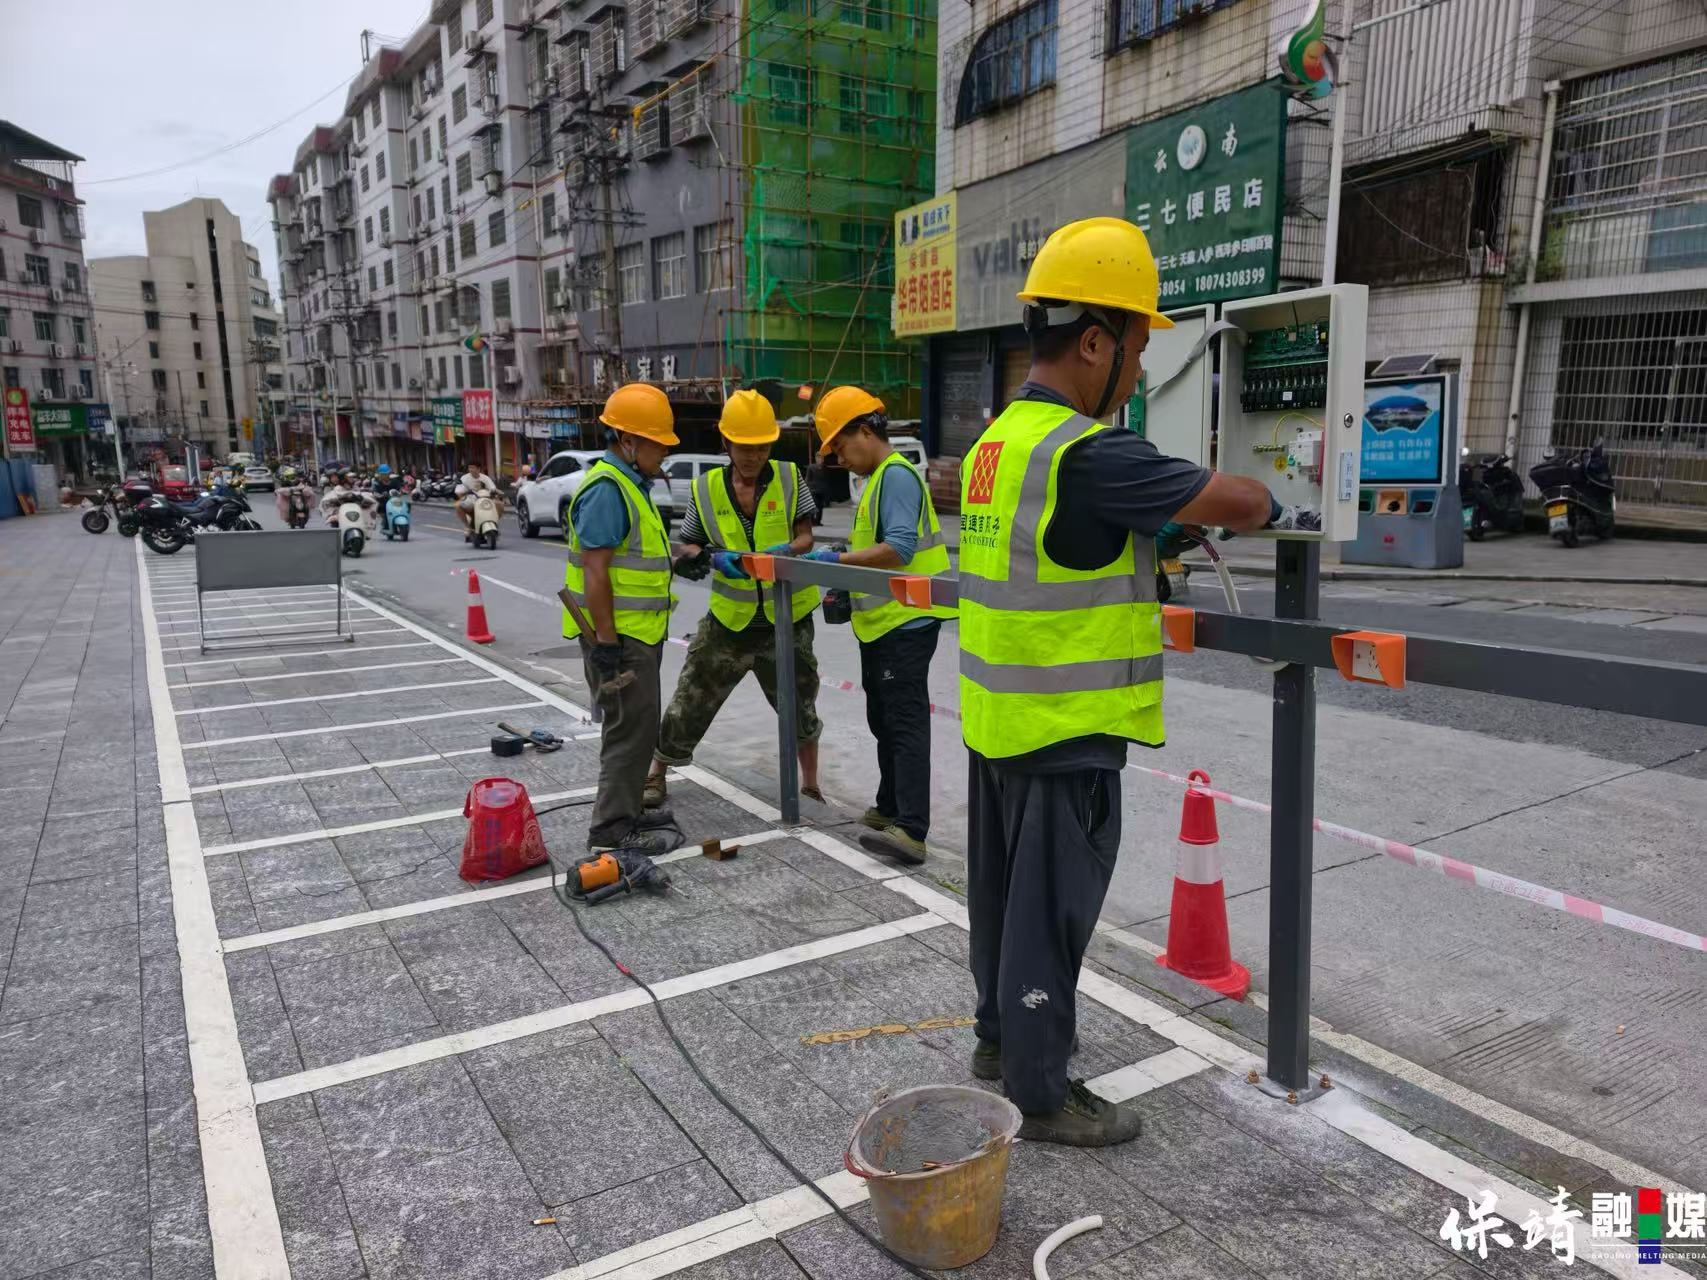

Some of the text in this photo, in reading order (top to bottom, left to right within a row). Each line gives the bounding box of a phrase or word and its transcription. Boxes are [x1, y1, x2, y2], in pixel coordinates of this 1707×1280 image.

[1137, 178, 1263, 232] 三七便民店
[1195, 267, 1266, 292] 18074308399
